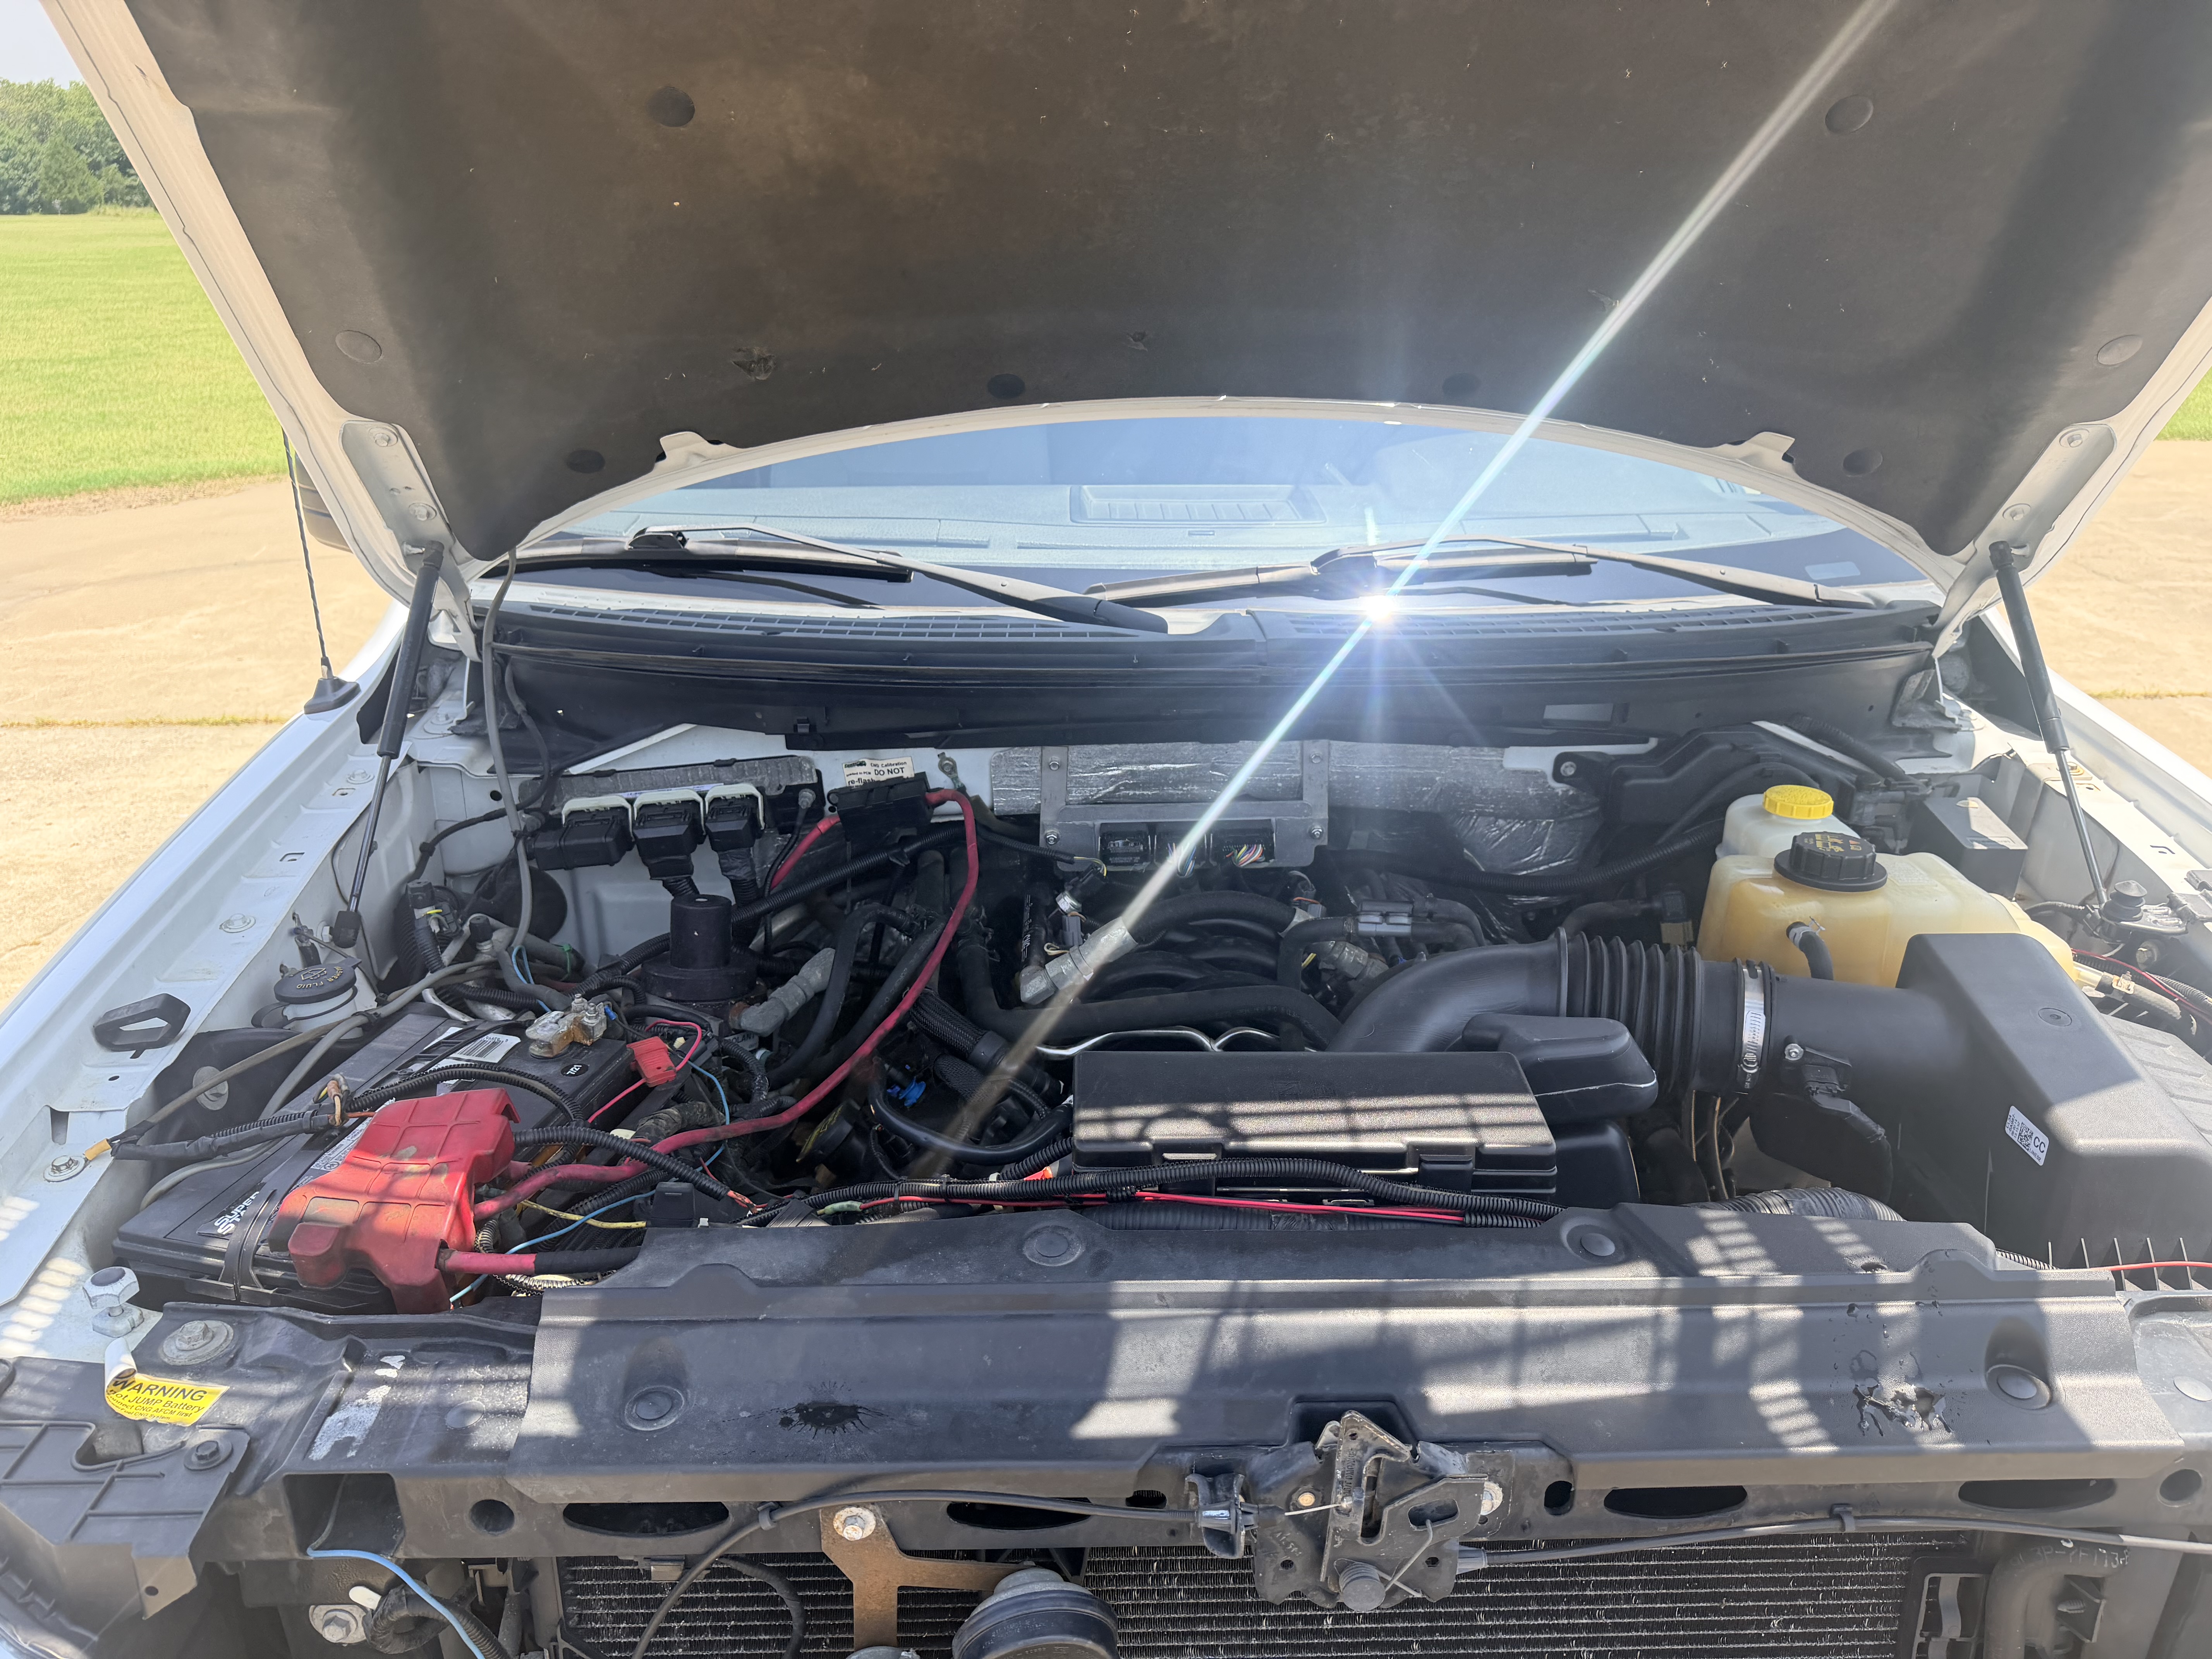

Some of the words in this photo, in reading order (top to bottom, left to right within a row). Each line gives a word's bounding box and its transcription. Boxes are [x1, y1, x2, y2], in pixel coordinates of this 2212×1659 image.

[732, 1033, 754, 1043] OLANT
[566, 1065, 582, 1075] 7/21
[2033, 1136, 2045, 1153] CC
[113, 1380, 207, 1401] WARNING
[128, 1395, 163, 1406] JUMP
[163, 1400, 204, 1413] Battery
